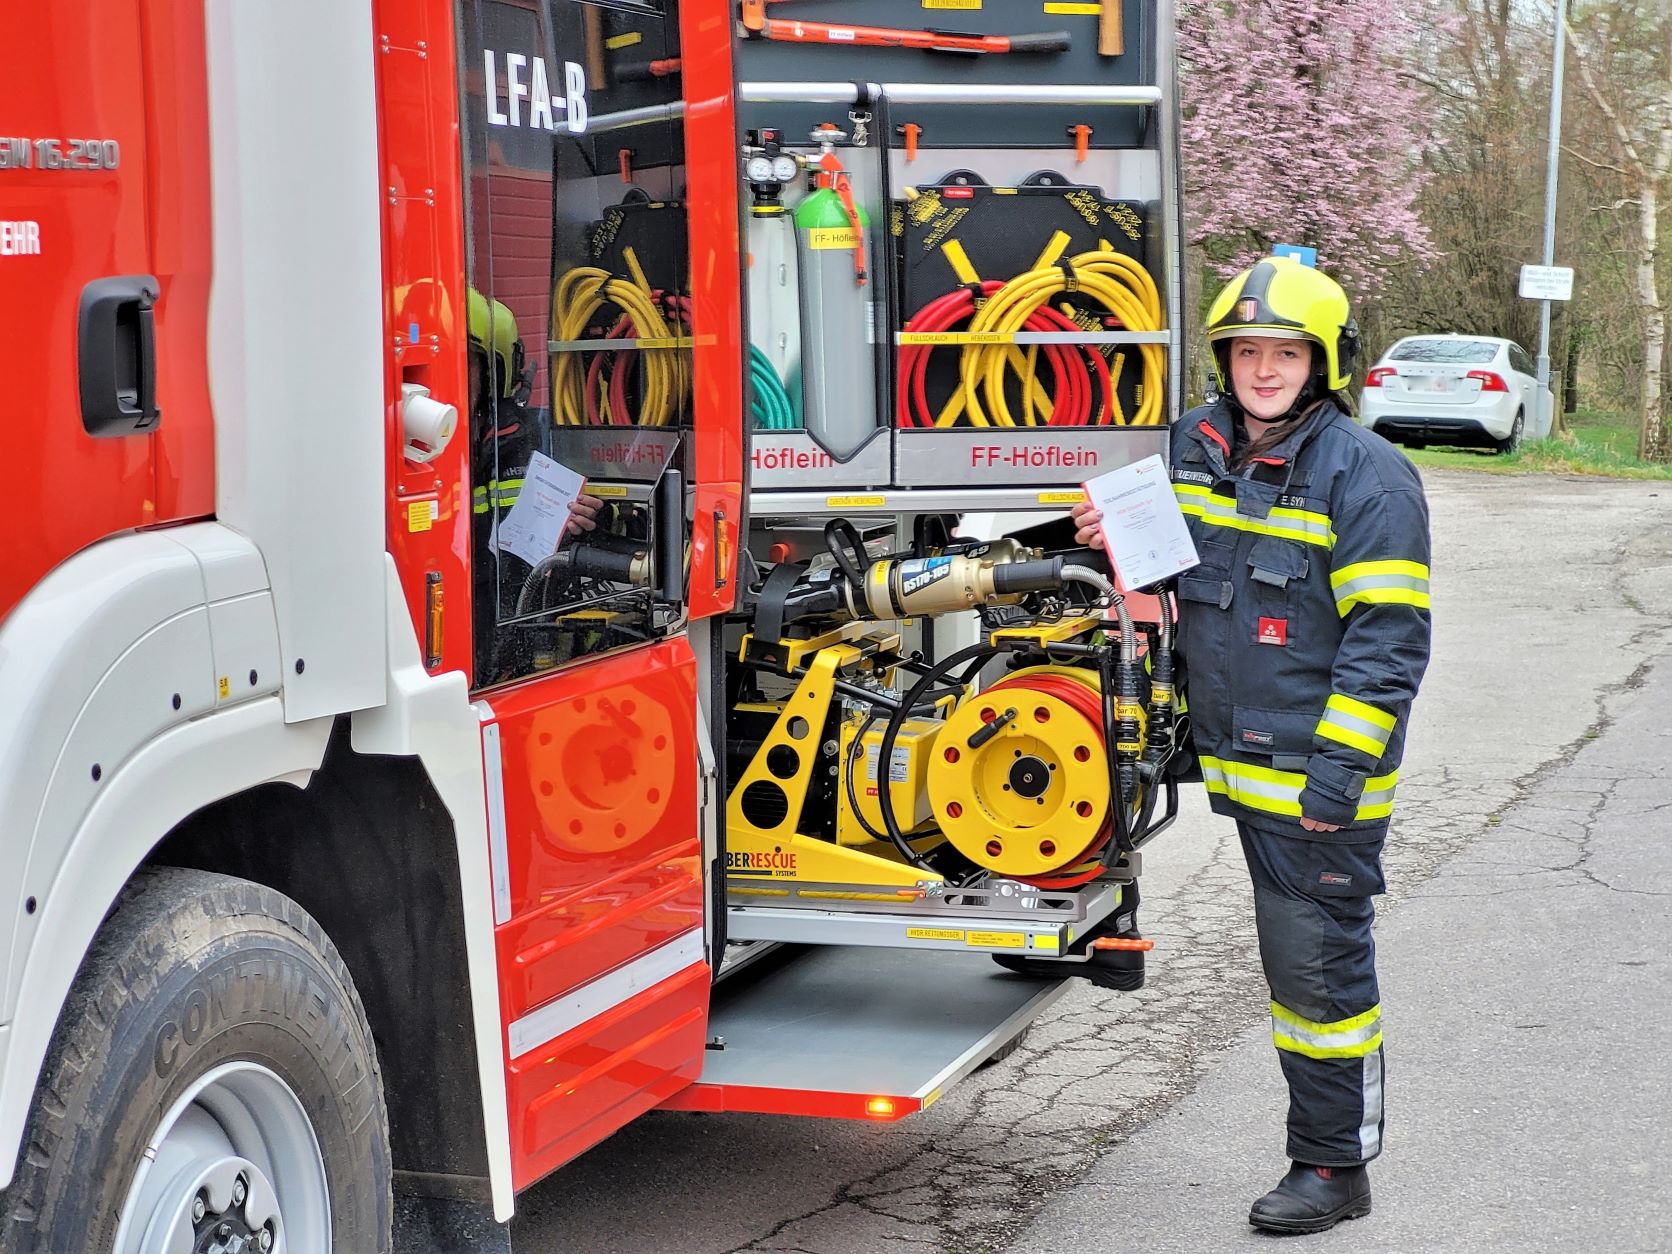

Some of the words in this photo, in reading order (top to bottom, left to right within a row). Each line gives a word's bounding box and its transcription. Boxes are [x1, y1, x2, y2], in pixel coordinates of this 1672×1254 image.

[484, 49, 588, 133] LFA-B
[33, 138, 120, 170] 16.290
[971, 445, 1098, 468] FF-Höflein
